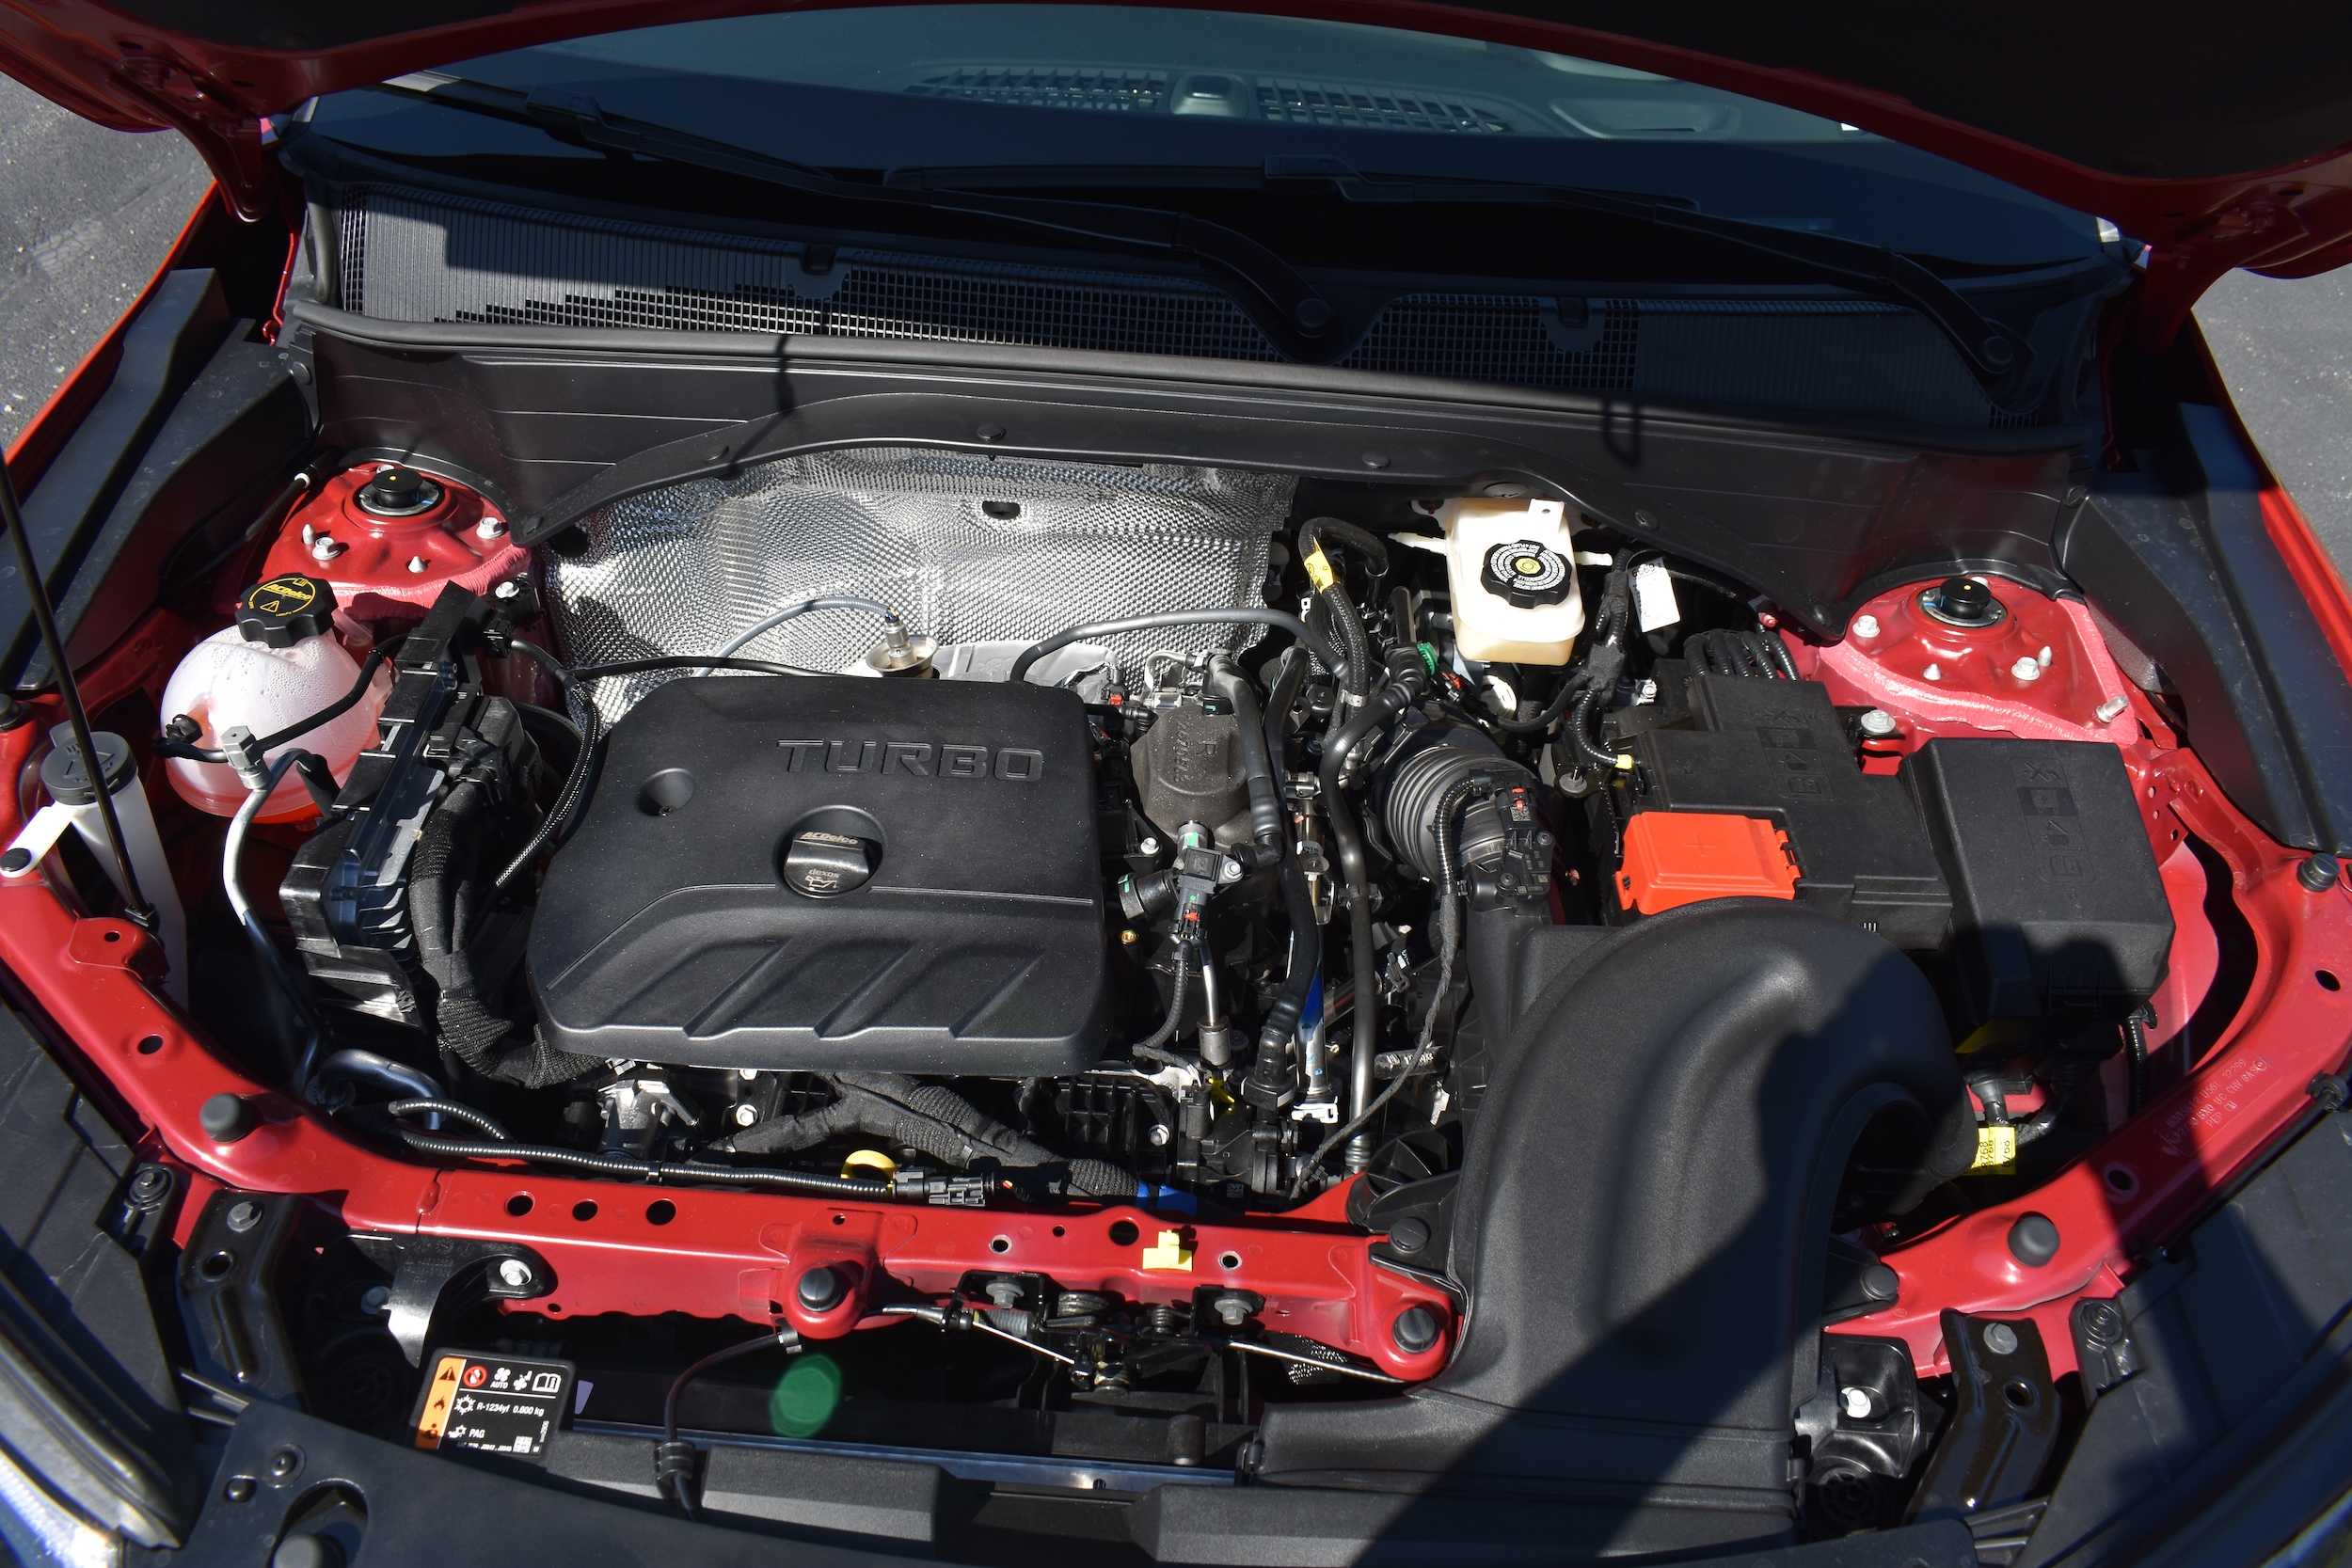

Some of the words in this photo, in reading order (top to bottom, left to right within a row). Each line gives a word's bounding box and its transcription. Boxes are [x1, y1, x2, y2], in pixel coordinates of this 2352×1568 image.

[264, 583, 312, 601] ACDelco
[778, 739, 1043, 782] TURBO
[800, 832, 858, 845] ACDelco
[808, 869, 840, 879] dexos
[490, 1381, 509, 1389] AUTO
[476, 1402, 511, 1414] R-1234yf
[512, 1405, 533, 1415] 0.600
[533, 1407, 545, 1418] kg
[469, 1428, 485, 1439] PAG
